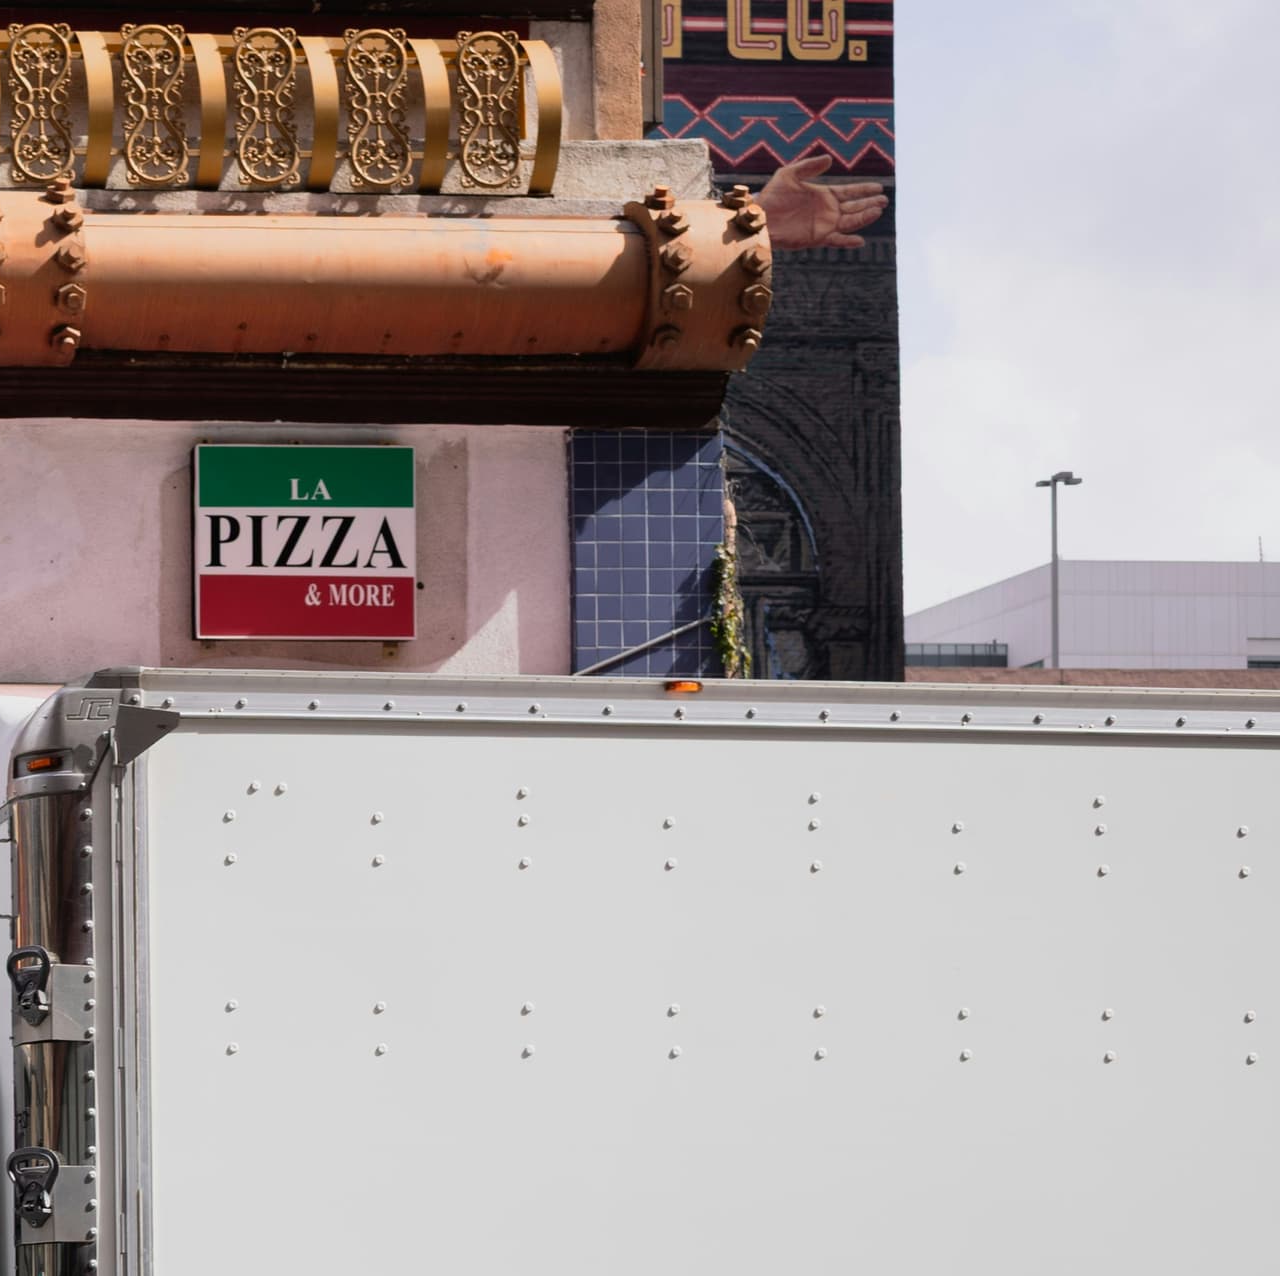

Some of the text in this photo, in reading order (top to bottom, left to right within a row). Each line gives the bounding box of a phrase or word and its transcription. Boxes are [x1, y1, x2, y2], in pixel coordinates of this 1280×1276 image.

[289, 478, 332, 501] LA
[204, 514, 408, 569] PIZZA
[303, 582, 395, 607] & MORE
